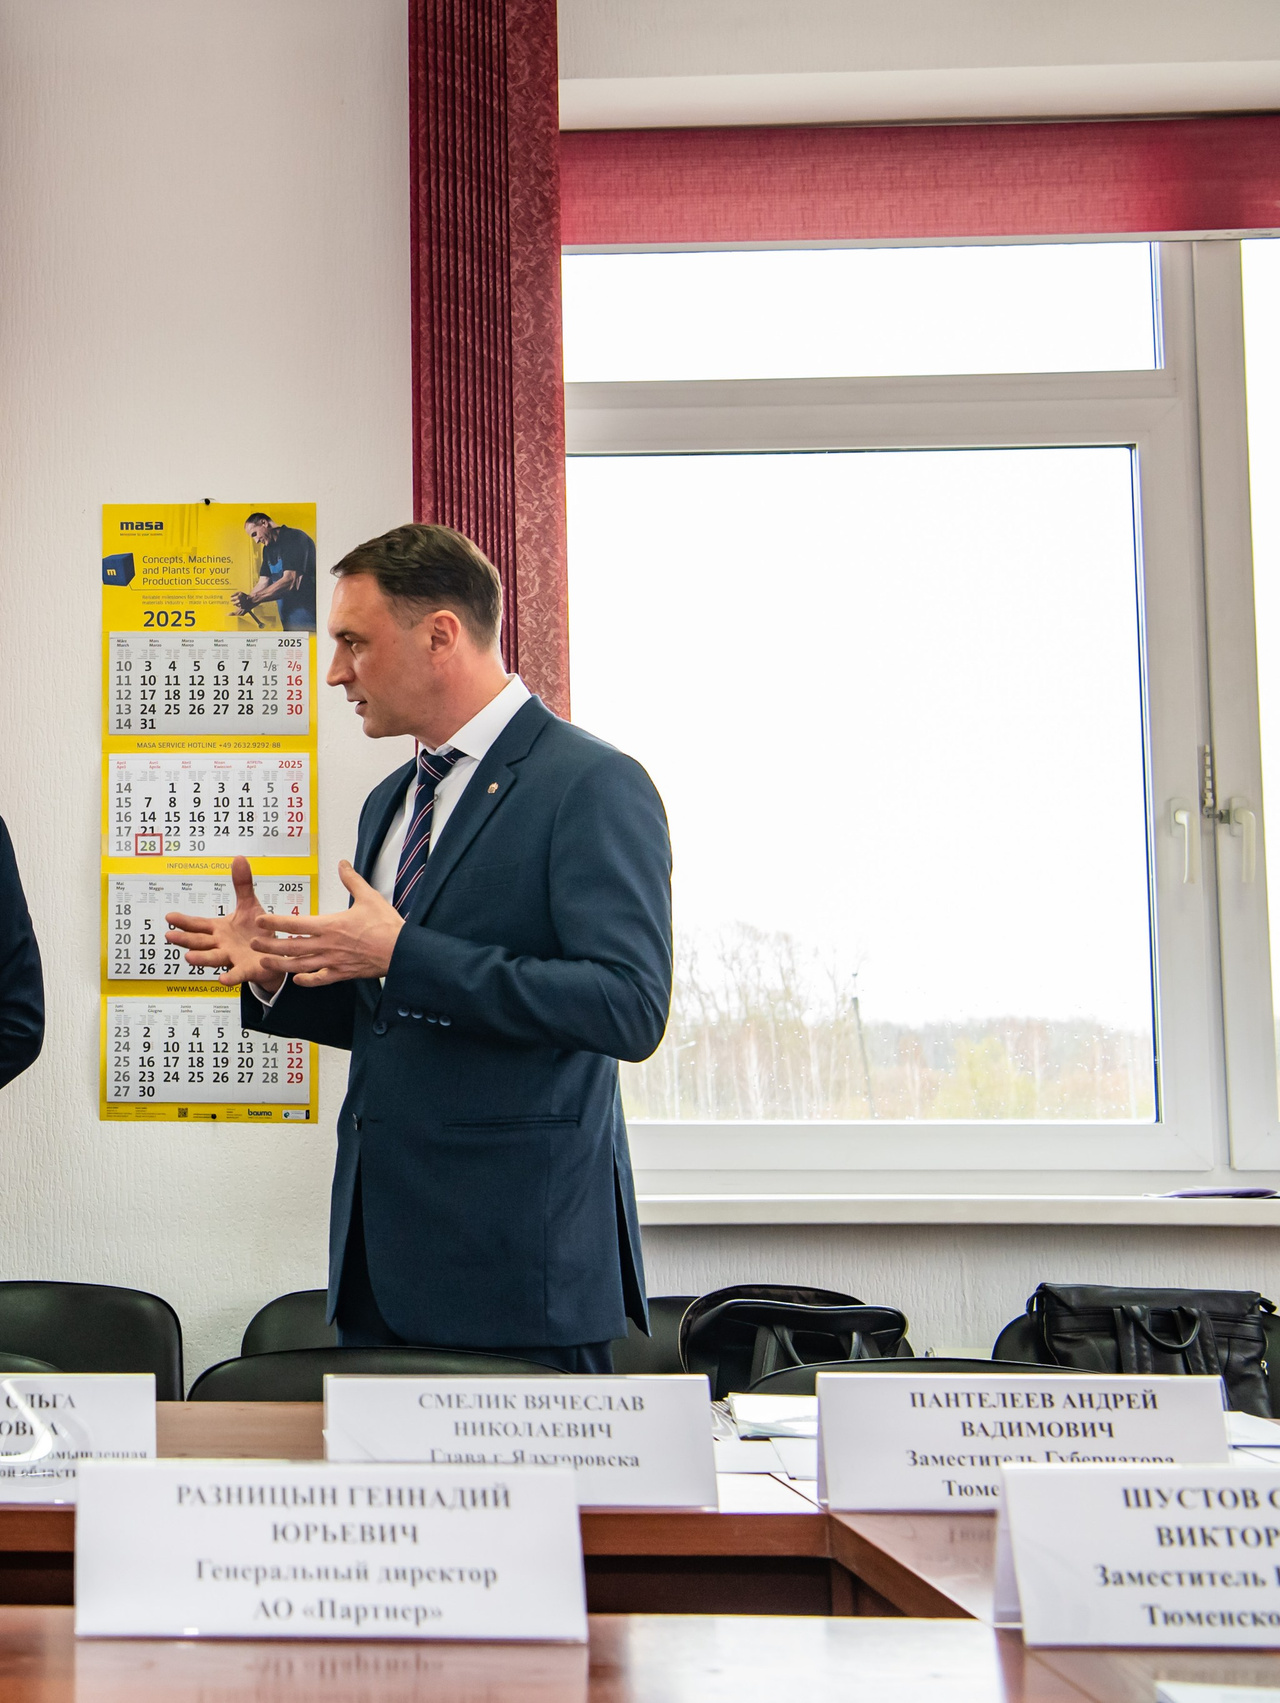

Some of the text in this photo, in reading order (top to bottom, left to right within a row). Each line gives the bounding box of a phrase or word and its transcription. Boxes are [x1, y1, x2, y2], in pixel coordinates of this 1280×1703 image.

[120, 521, 164, 531] masa
[142, 555, 234, 565] Concepts, Machines,
[142, 566, 231, 577] and Plants for your
[142, 576, 232, 586] Production Success.
[143, 610, 196, 627] 2025
[277, 638, 302, 648] 2025
[116, 660, 302, 672] 10 3 4 5 6 7 1/8 2/9
[115, 674, 303, 687] 11 10 11 12 13 14 15 16
[115, 689, 303, 701] 12 17 18 19 20 21 22 23
[115, 703, 303, 716] 13 24 25 26 27 28 29 30
[278, 760, 303, 769] 2025
[115, 796, 303, 809] 15 7 8 9 10 11 12 13
[115, 810, 304, 823] 16 14 15 16 17 18 19 20
[278, 883, 304, 893] 2025
[114, 962, 180, 975] 22 26 27
[113, 1055, 304, 1069] 25 16 17 18 19 20 21 22
[247, 1109, 273, 1117] bauma
[418, 1393, 645, 1412] СМЕЛИК ВЯЧЕСЛАВ
[910, 1388, 1159, 1410] ПАНТЕЛЕЕВ АНДРЕЙ
[453, 1421, 613, 1439] НИКОЛАЕВИЧ
[960, 1420, 1115, 1438] ВАДИМОВИЧ
[430, 1449, 487, 1463] Глава
[176, 1482, 513, 1511] РАЗНИЦЫН ГЕННАДИЙ
[1122, 1487, 1261, 1509] ШУСТОВ
[271, 1522, 420, 1545] ЮРЬЕВИЧ
[1155, 1526, 1280, 1548] ВИКТОР
[195, 1559, 499, 1589] Генеральный директор
[1094, 1564, 1268, 1587] Заместитель
[254, 1599, 444, 1626] АО «Партнер»
[1140, 1604, 1280, 1627] Тюменско
